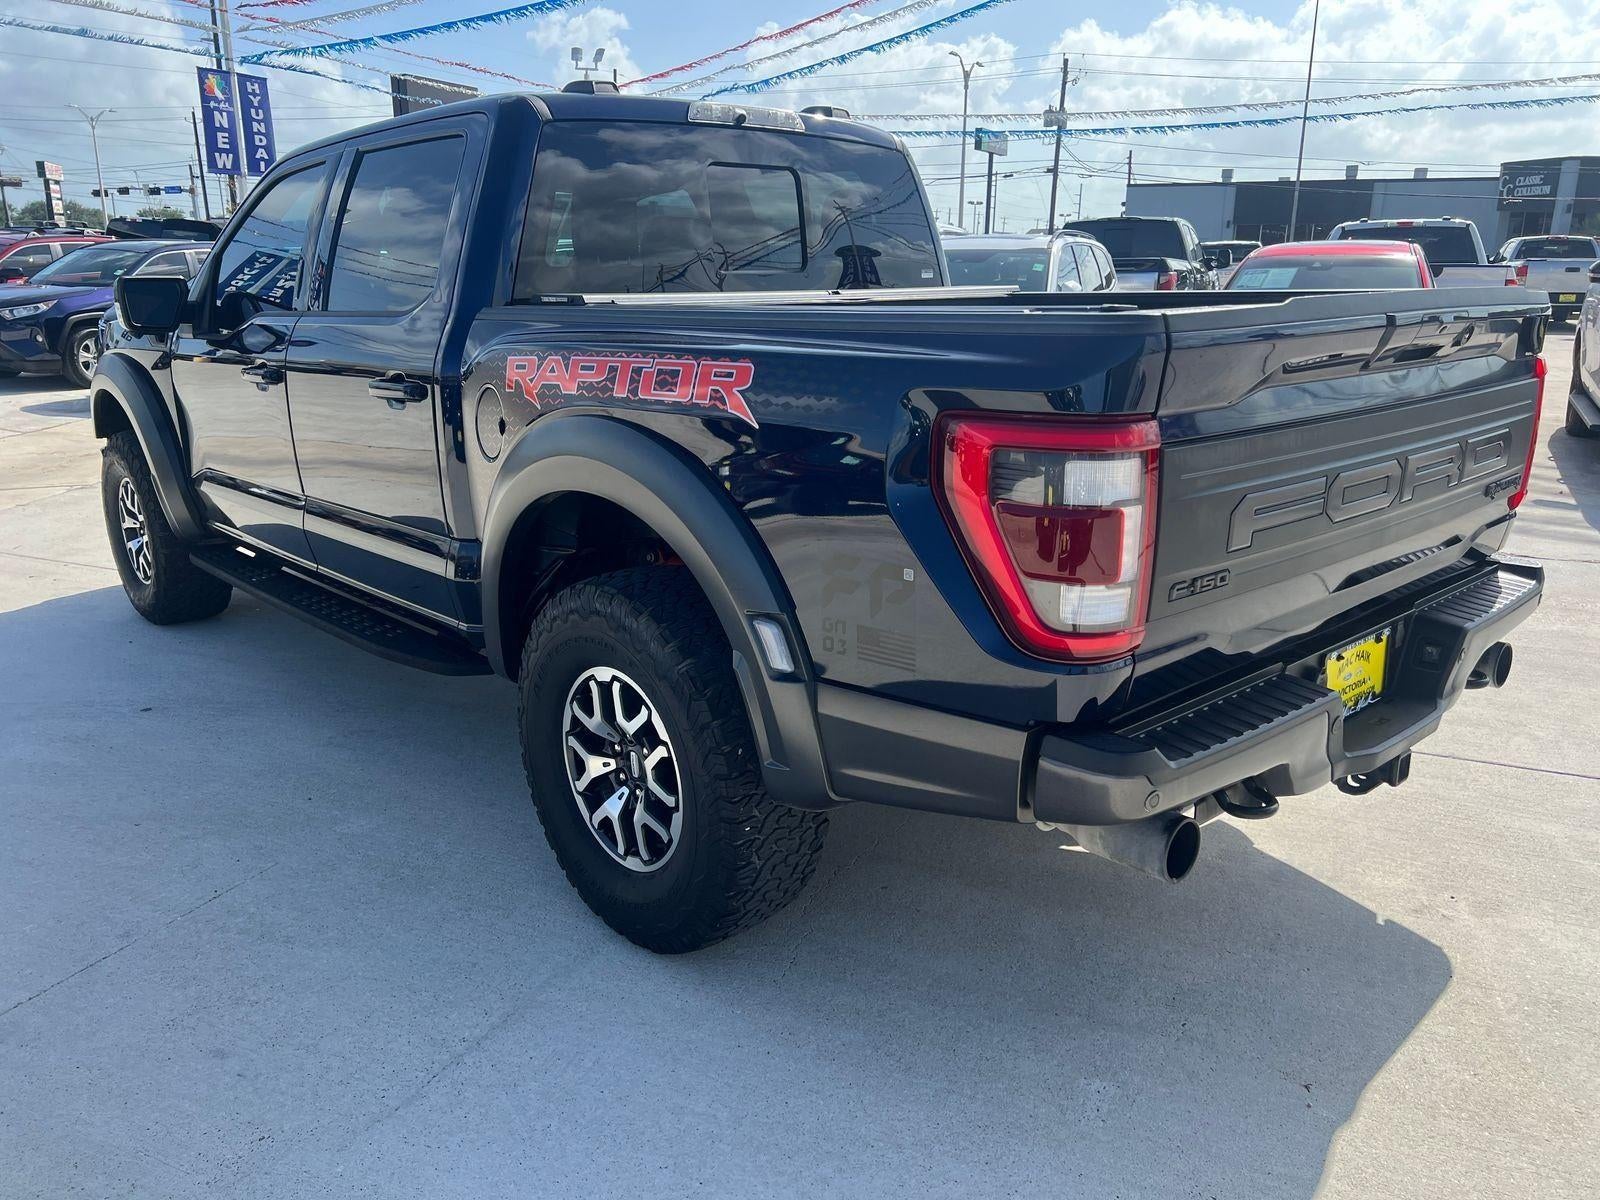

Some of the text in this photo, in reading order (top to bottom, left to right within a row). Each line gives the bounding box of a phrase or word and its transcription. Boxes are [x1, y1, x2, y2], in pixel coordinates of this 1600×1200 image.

[213, 111, 234, 169] NEW
[246, 82, 268, 172] HYUNDAI
[1514, 185, 1551, 197] COLLISION
[1516, 175, 1544, 186] CLASSIC
[505, 355, 759, 429] RAPTOR
[1226, 428, 1510, 552] FORD
[1168, 568, 1230, 602] F-150
